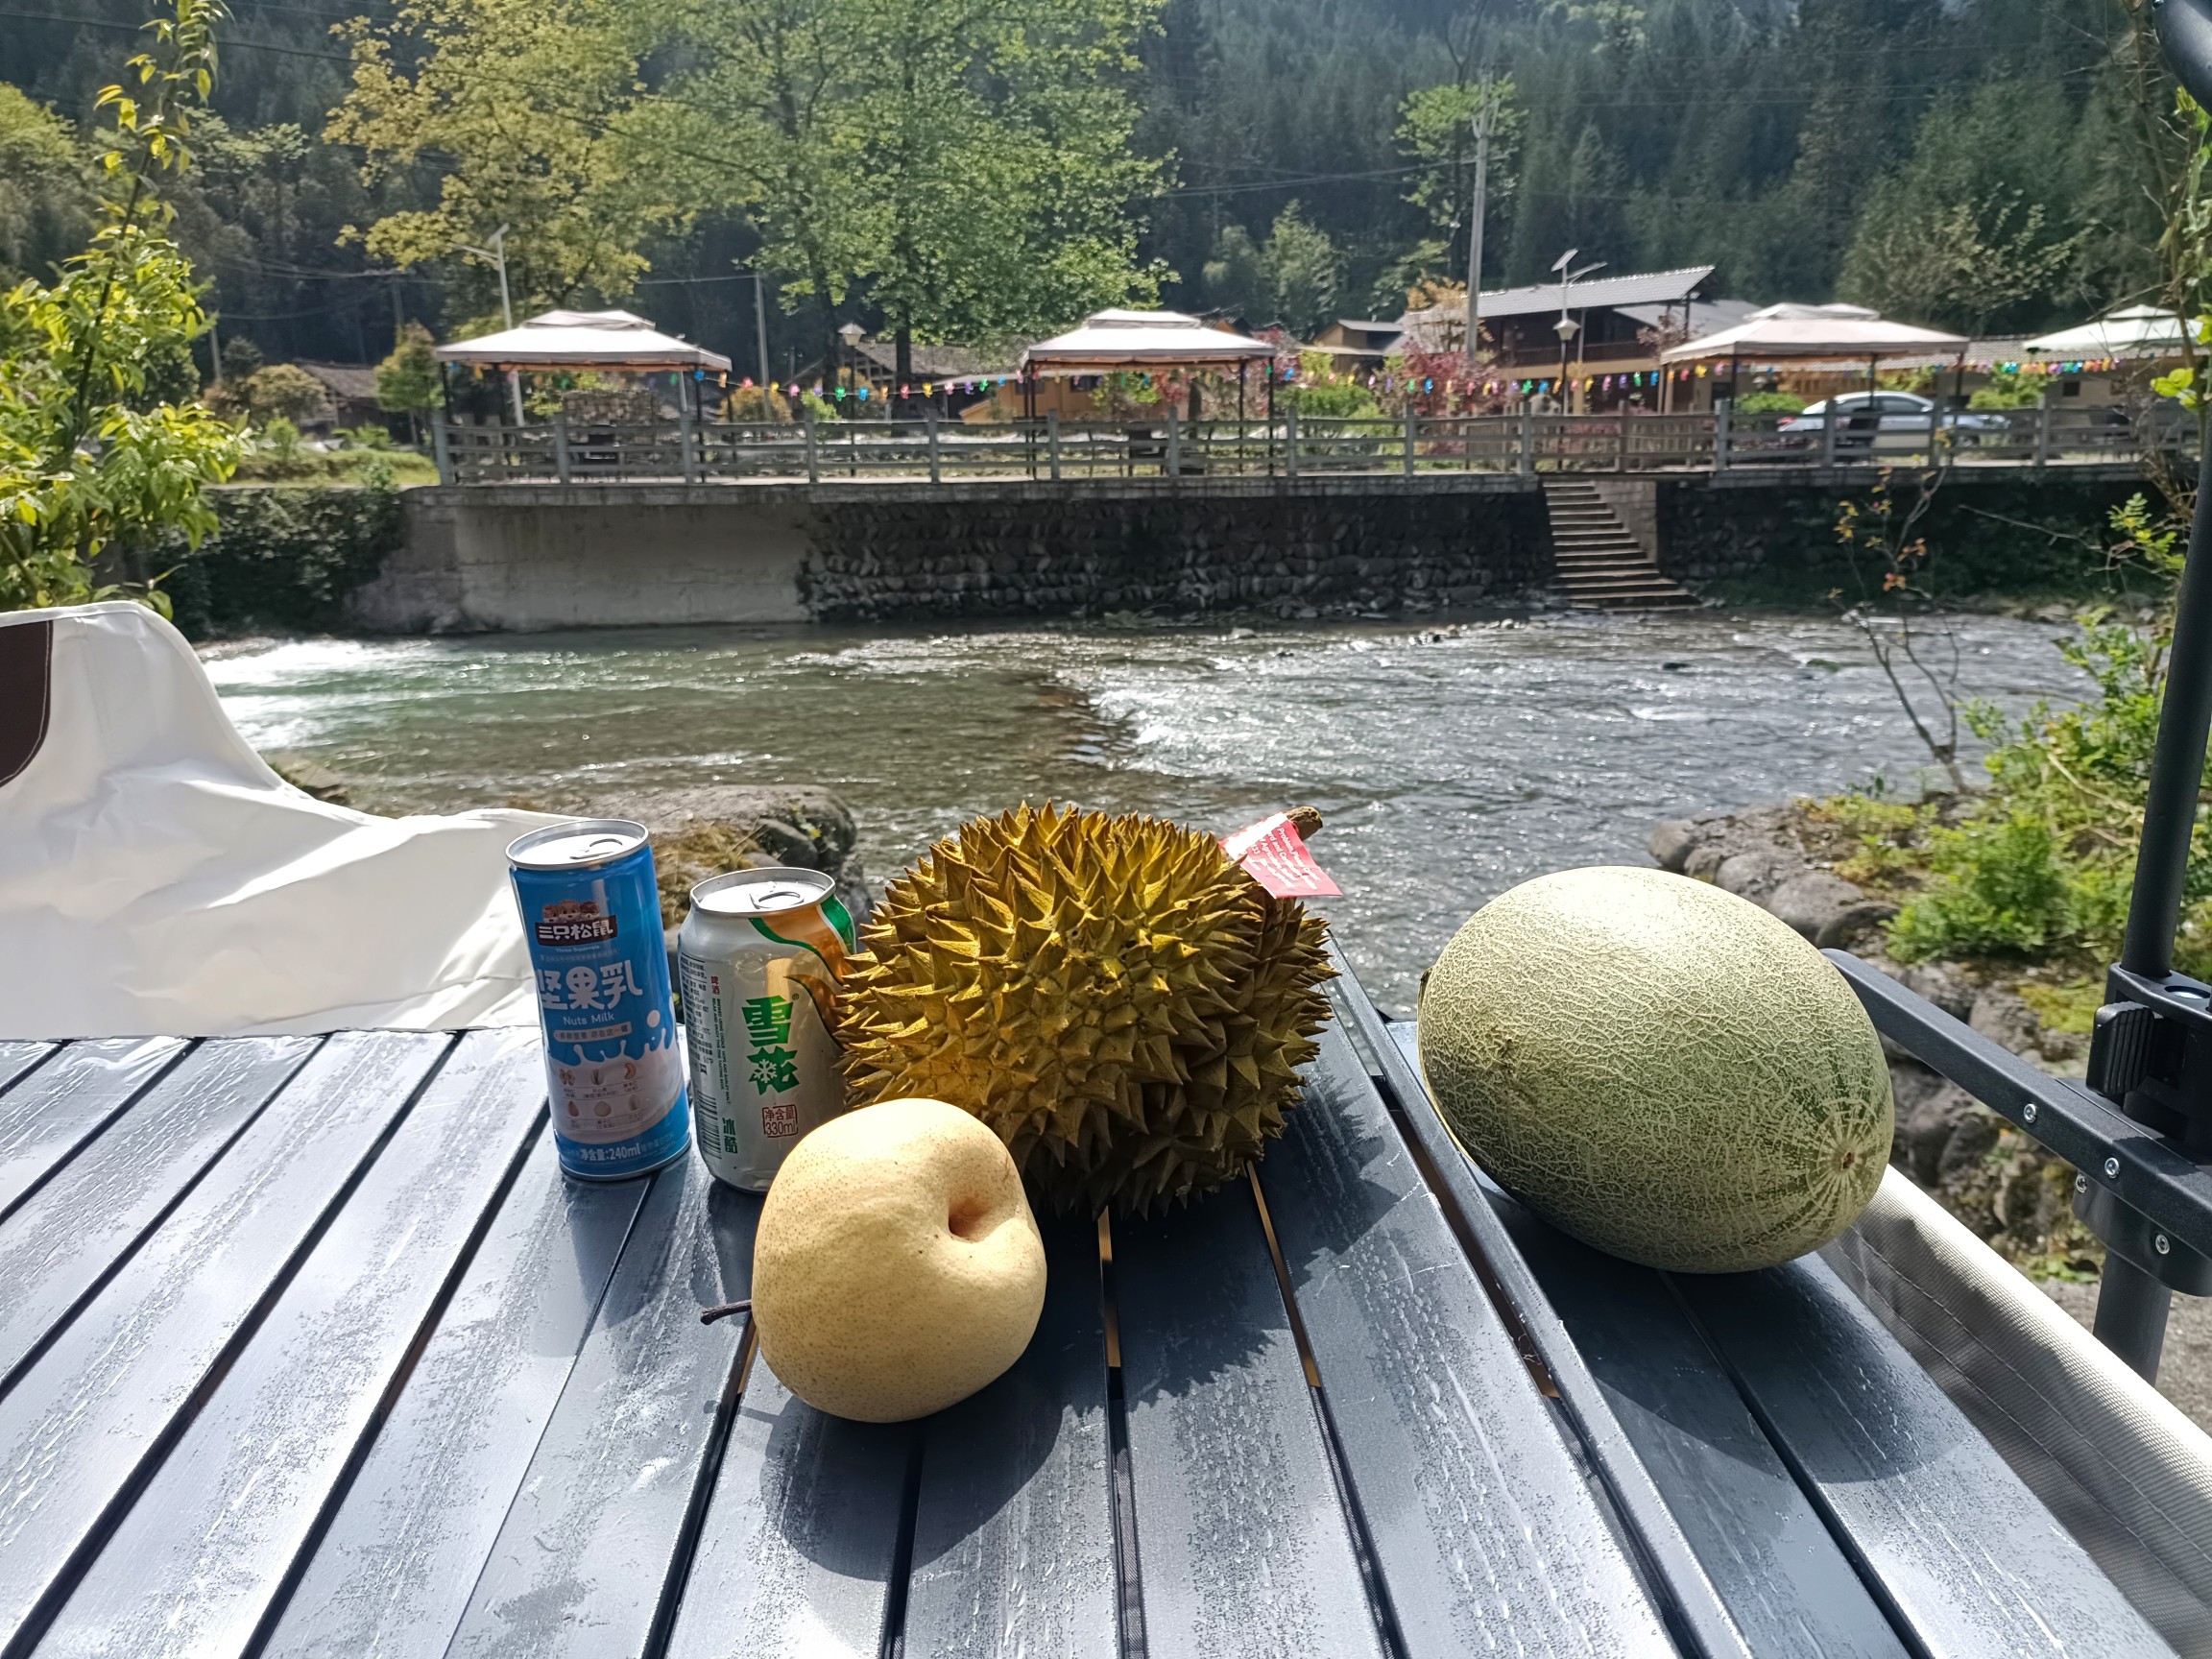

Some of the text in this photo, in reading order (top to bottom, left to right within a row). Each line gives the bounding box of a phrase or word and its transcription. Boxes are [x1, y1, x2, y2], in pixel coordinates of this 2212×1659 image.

[539, 920, 613, 940] 三只松鼠
[537, 959, 643, 1010] 坚果乳
[563, 1011, 614, 1025] Nuts Milk
[741, 995, 800, 1095] 雪花
[764, 1106, 795, 1121] 净含量
[722, 1118, 738, 1154] 冰酷
[765, 1119, 796, 1136] 330ml
